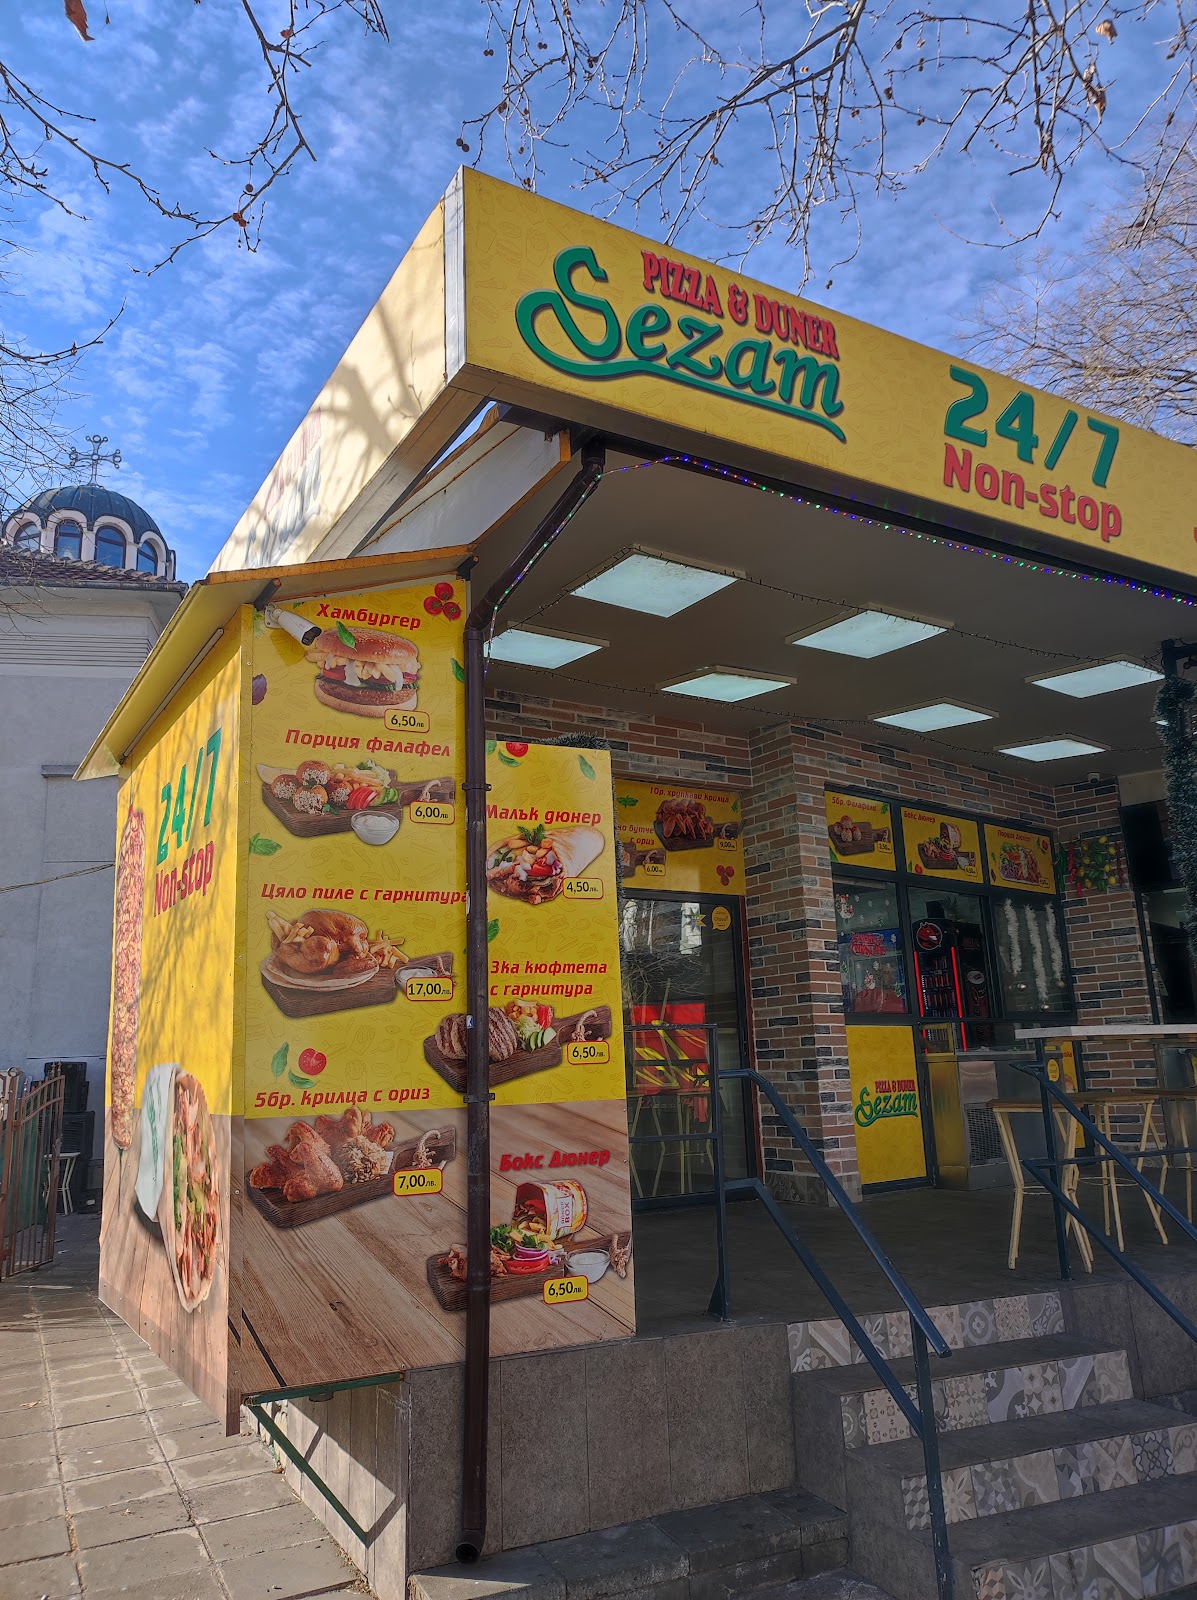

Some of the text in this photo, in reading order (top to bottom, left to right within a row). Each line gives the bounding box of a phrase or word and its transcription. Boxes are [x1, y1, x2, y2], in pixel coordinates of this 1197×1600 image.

[640, 250, 840, 359] PIZZA & DUNER
[515, 246, 846, 444] Sezam
[944, 365, 1120, 488] 24/7
[943, 443, 1122, 542] Non-stop
[316, 603, 421, 630] Хамбургер
[285, 729, 451, 757] Порция фалафел
[157, 727, 222, 866] 24/7
[486, 805, 602, 826] Малък дюнер
[154, 840, 214, 918] Non-stop
[261, 883, 307, 901] Цяло
[312, 887, 355, 901] пиле
[360, 889, 369, 901] с
[524, 960, 607, 976] кюфтета
[490, 982, 593, 997] с гарнитура
[254, 1087, 431, 1109] 5бр. крилца с ориз
[855, 1086, 918, 1127] Sezam
[500, 1149, 611, 1172] Бокс Дюнер
[397, 1174, 437, 1189] 7,00лв.
[547, 1280, 584, 1298] 6,50лв.
